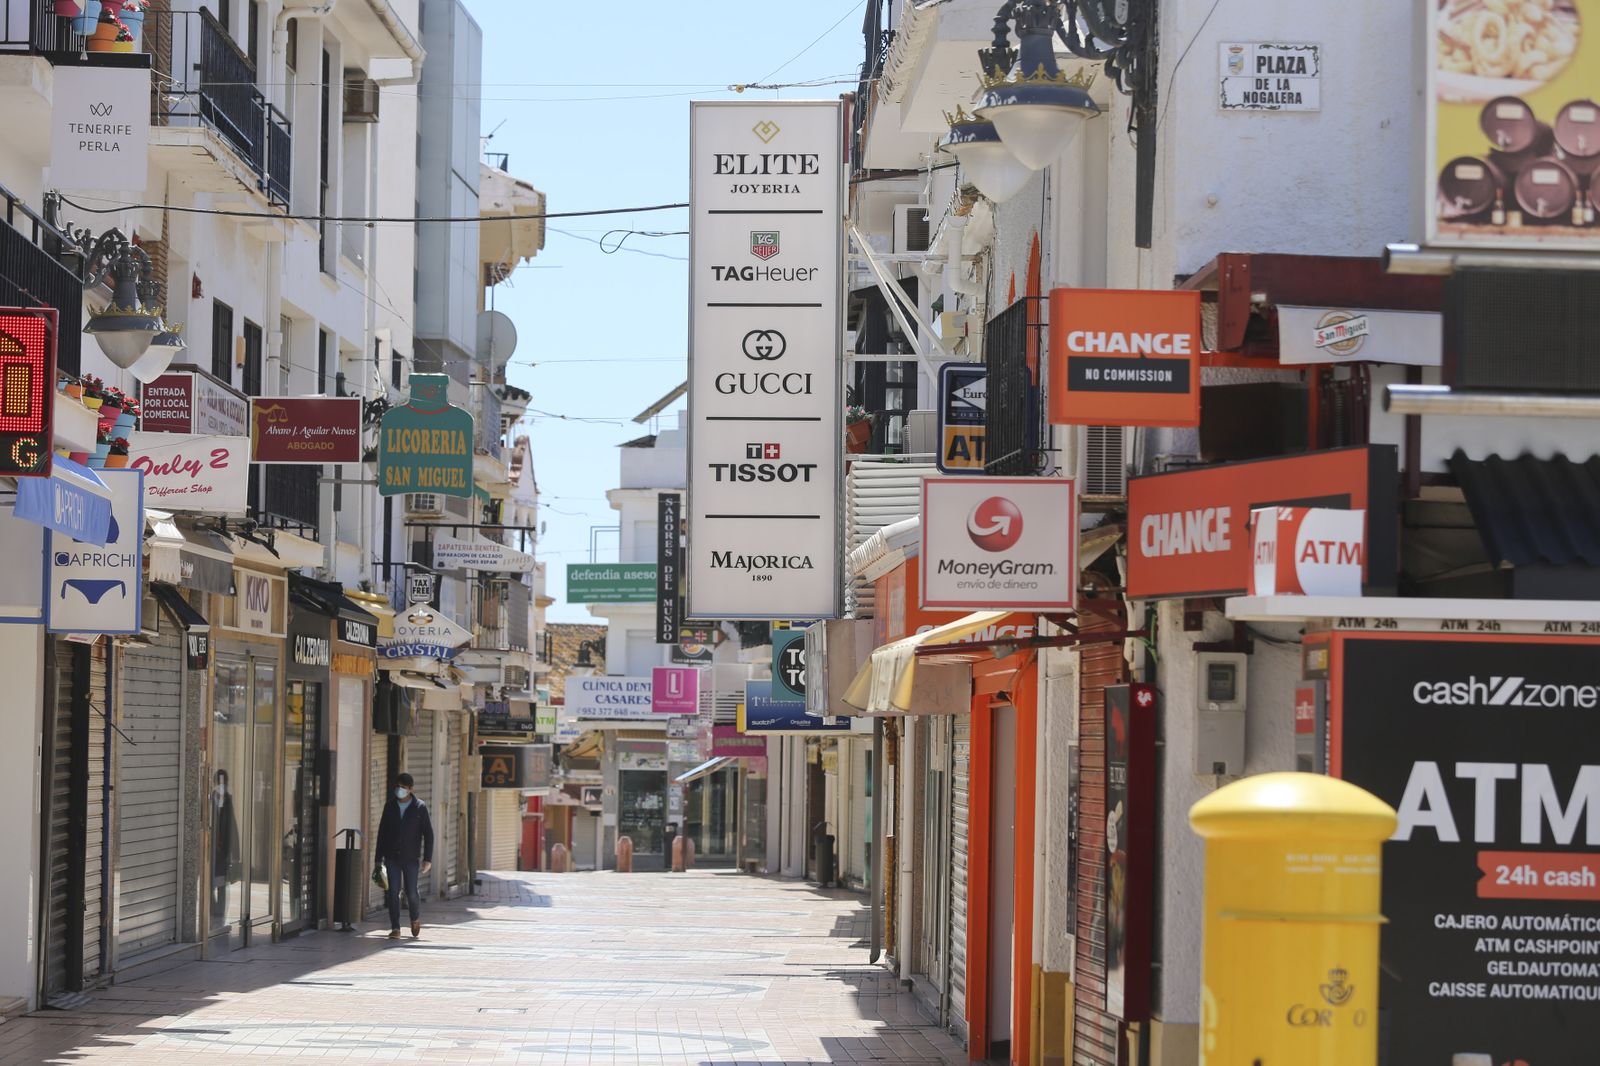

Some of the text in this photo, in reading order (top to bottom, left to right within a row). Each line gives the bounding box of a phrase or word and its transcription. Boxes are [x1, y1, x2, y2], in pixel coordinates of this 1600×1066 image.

[1256, 55, 1307, 75] PLAZA
[1255, 78, 1290, 91] DE LA
[1243, 91, 1303, 105] NOGALERA
[68, 123, 132, 136] TENERIFE
[79, 141, 120, 152] PERLA
[713, 153, 820, 176] ELITE
[730, 184, 801, 194] JOYERIA
[1067, 330, 1192, 355] CHANGE
[1085, 368, 1173, 383] NO COMMISSION
[715, 372, 813, 395] GUCCI
[148, 387, 186, 397] ENTRADA
[144, 398, 190, 409] POR LOCAL
[143, 410, 190, 420] COMERCIAL
[300, 426, 329, 439] Aguilar
[331, 426, 357, 436] Navas
[287, 442, 335, 450] ABOGADO
[387, 428, 467, 455] LICORERIA
[12, 437, 38, 468] G
[209, 448, 230, 469] 2
[386, 465, 466, 489] SAN MIGUEL
[708, 463, 818, 483] TISSOT
[149, 484, 213, 497] Different Shop
[1140, 507, 1231, 558] CHANGE
[55, 551, 136, 568] CAPRICHI
[1301, 540, 1363, 566] ATM
[571, 569, 621, 581] defendia
[663, 498, 674, 641] SABORES DEL MUNDO
[937, 559, 1055, 579] MoneyGram
[414, 579, 429, 587] TAX
[987, 580, 1002, 590] de
[1003, 580, 1039, 590] dinero
[246, 575, 270, 614] KIKO
[412, 587, 430, 595] FREE
[1337, 618, 1366, 629] ATM
[1373, 618, 1398, 630] 24h
[1440, 620, 1501, 632] ATM 24h
[1543, 622, 1572, 633] ATM
[386, 644, 450, 660] CRYSTAL
[595, 695, 651, 705] CASARES
[582, 708, 596, 716] 952
[1393, 761, 1600, 846] ATM
[1496, 865, 1595, 887] 24h cash
[1434, 914, 1498, 930] CAJERO
[1474, 938, 1510, 953] ATM
[1429, 982, 1487, 998] CAISSE
